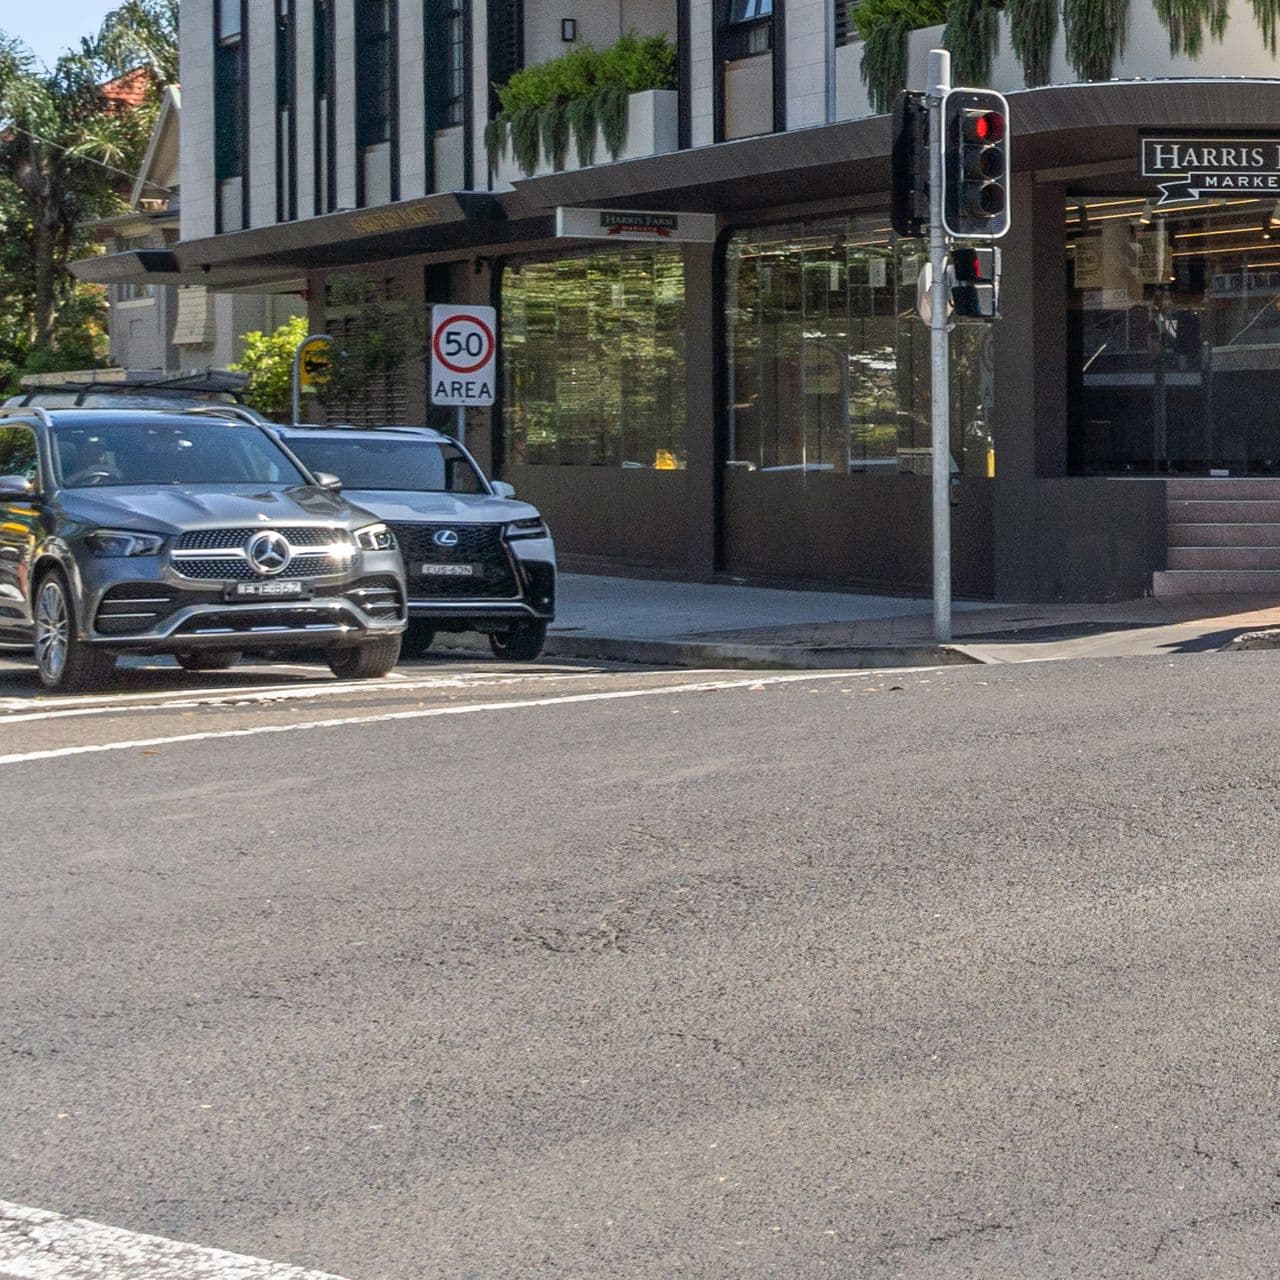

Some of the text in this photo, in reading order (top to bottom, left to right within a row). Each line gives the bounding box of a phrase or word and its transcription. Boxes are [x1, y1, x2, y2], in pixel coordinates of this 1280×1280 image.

[1153, 144, 1264, 169] HARRIS
[606, 214, 673, 227] HARRIS FARM
[445, 331, 483, 357] 50
[434, 381, 492, 399] AREA
